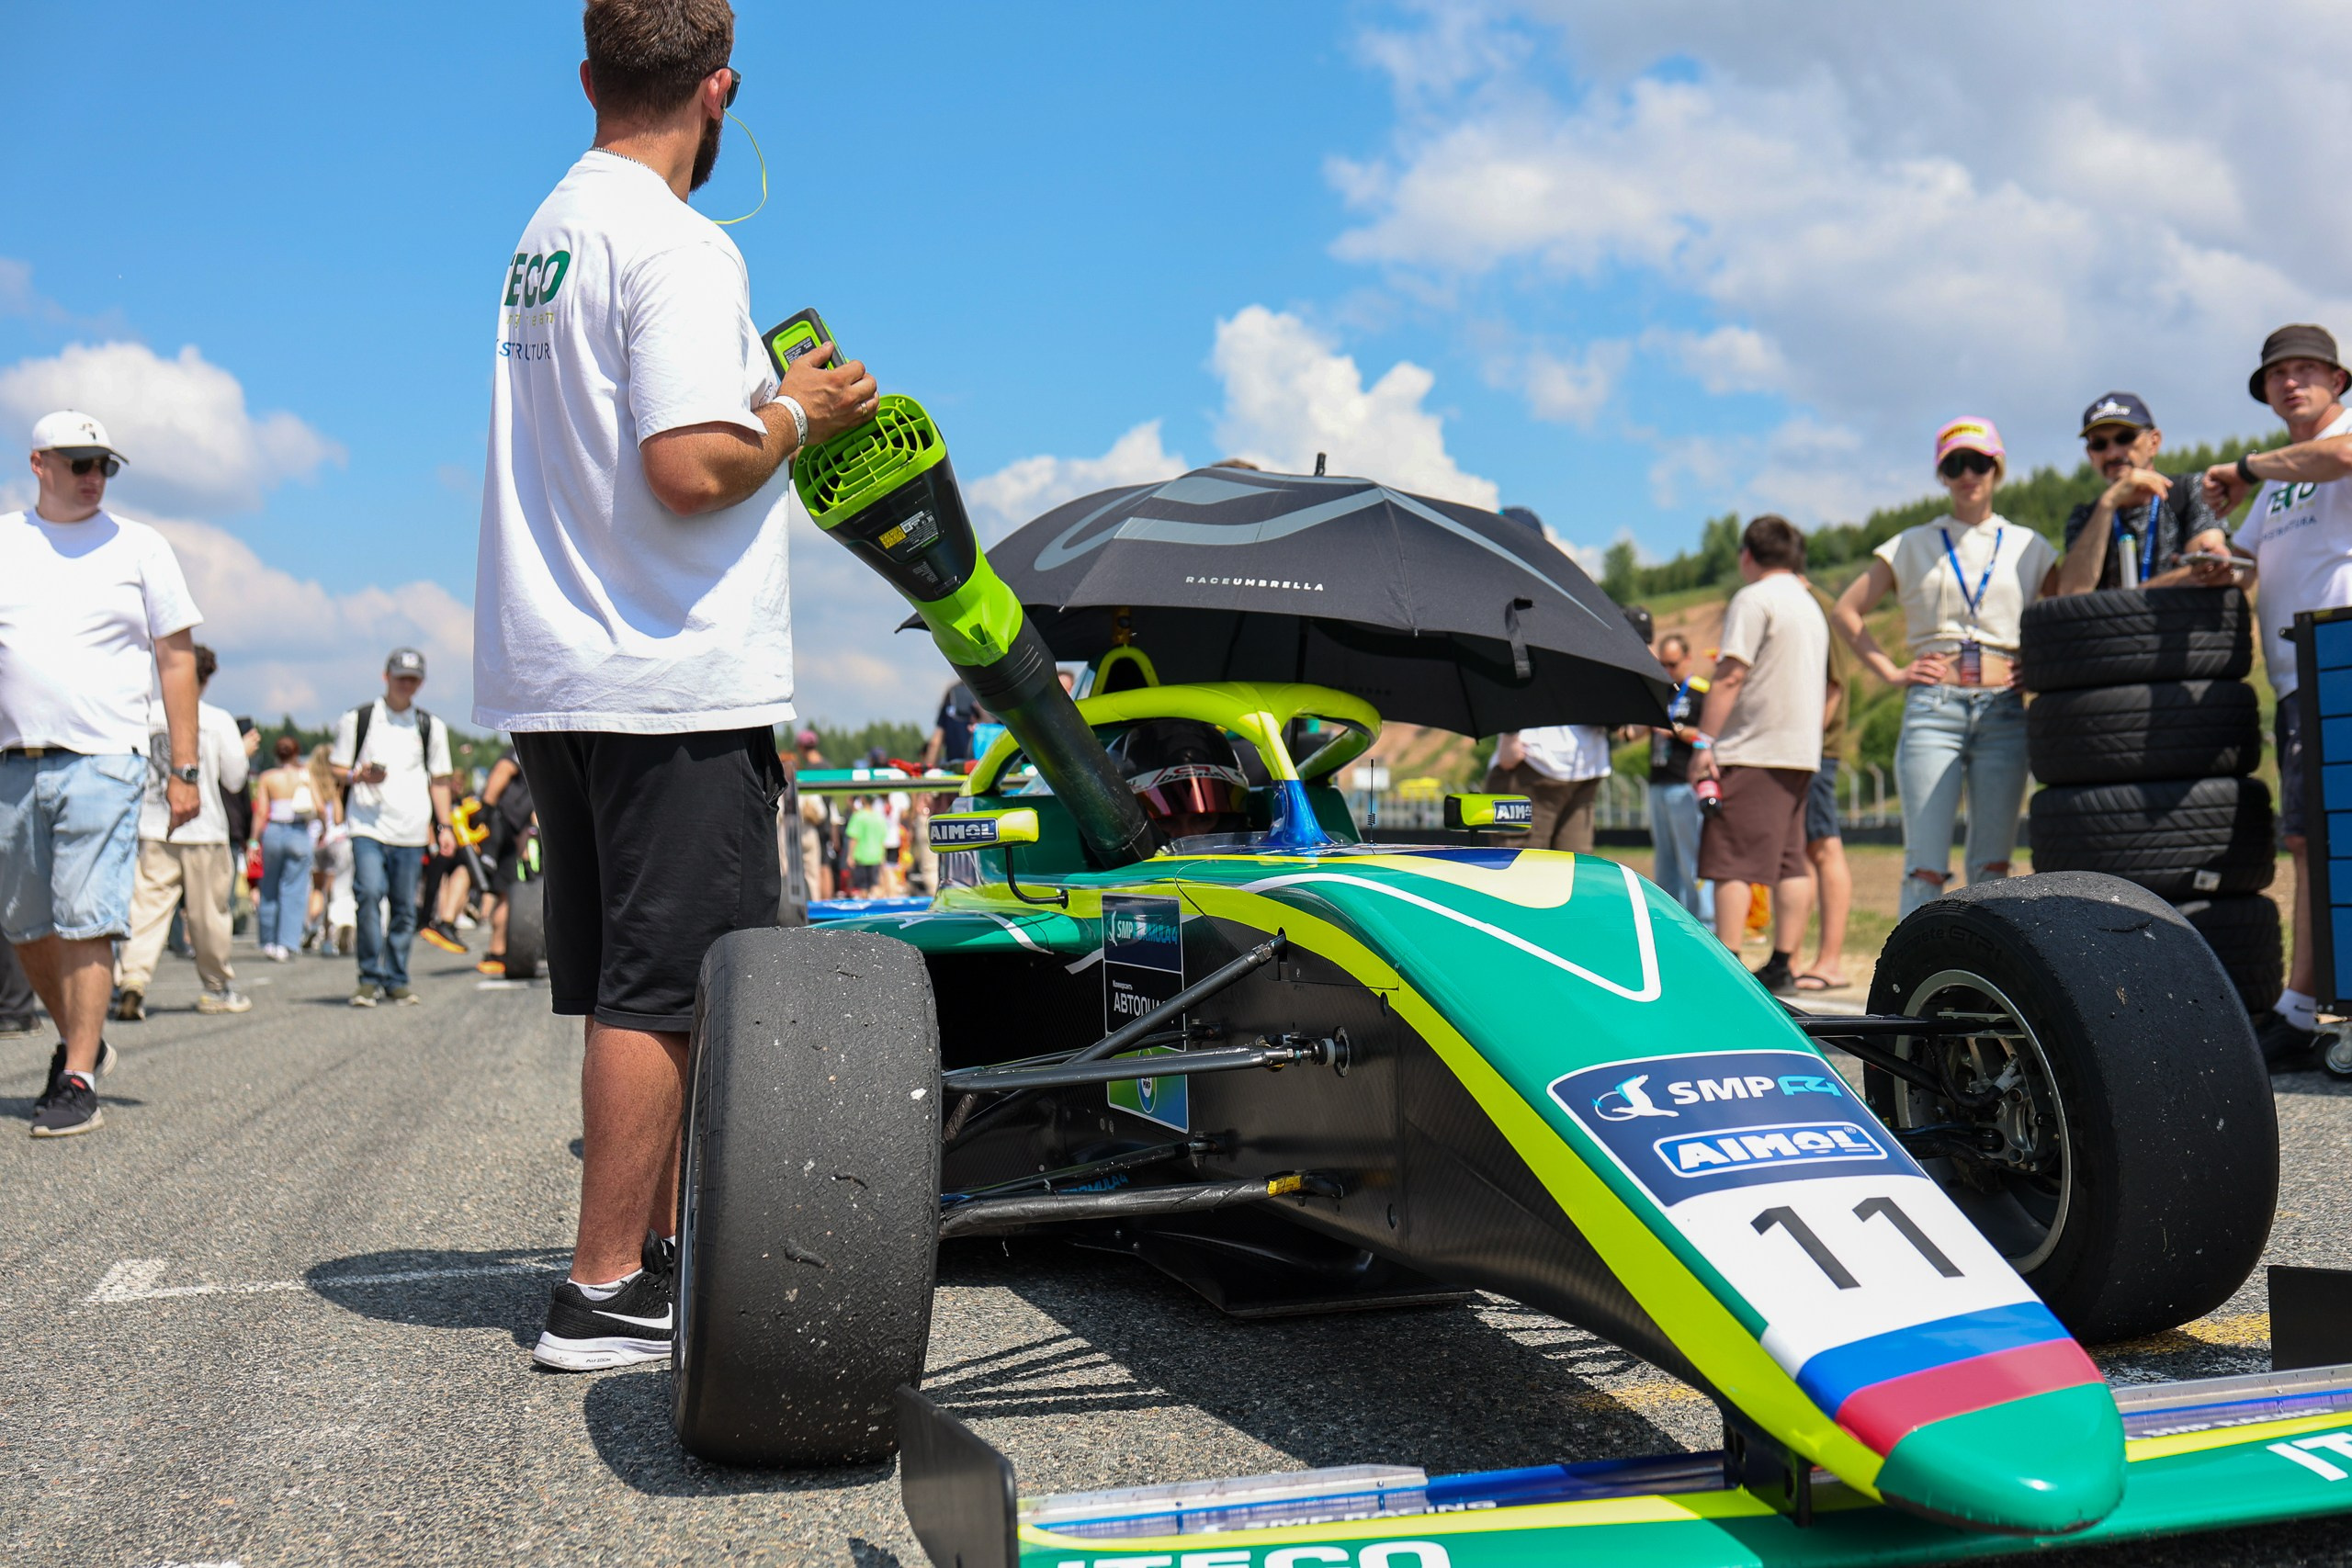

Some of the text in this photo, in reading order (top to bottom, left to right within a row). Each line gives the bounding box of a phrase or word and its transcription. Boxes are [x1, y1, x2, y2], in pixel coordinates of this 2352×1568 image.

[504, 250, 571, 308] ECO
[1185, 576, 1324, 591] RACEUMBRELLA
[930, 824, 994, 840] AIMOL
[1117, 919, 1133, 940] SMP
[1667, 1075, 1843, 1105] SMP F4
[1750, 1197, 1965, 1290] 11
